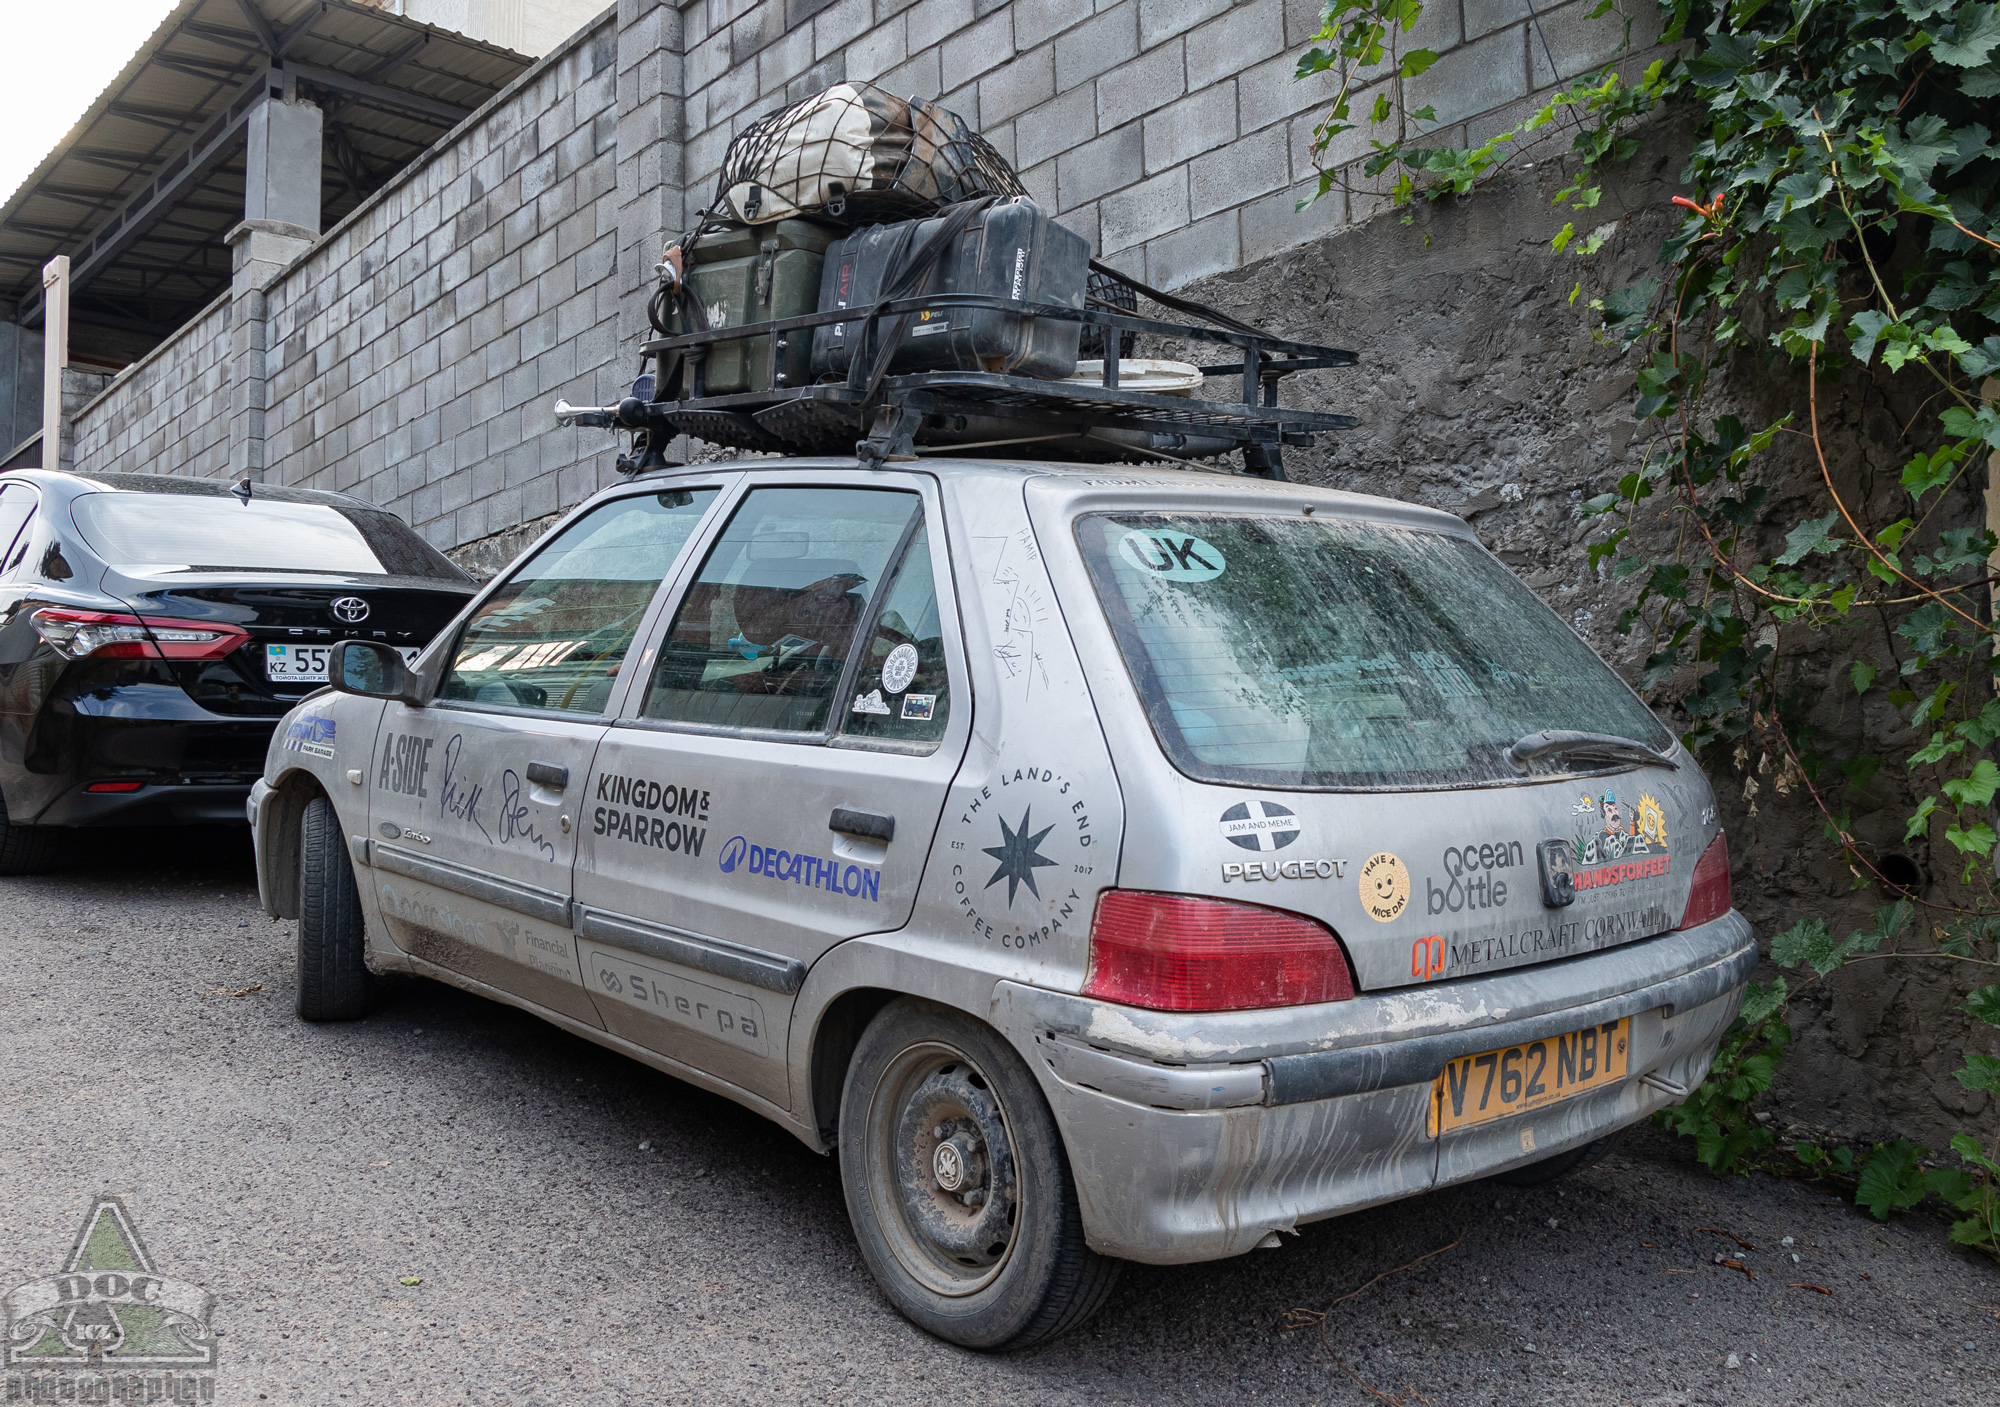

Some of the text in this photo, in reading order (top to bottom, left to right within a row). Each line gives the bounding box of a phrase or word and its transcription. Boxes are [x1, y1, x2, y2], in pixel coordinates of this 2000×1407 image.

[834, 263, 852, 337] PI AIR
[930, 310, 944, 318] PELI
[1124, 537, 1219, 572] UK
[288, 628, 413, 637] CAMRY
[269, 662, 287, 673] KZ
[295, 648, 331, 673] 55
[303, 745, 333, 757] PARK GARAGE
[596, 772, 711, 819] KINGDOM &
[961, 767, 1091, 847] THE LAND'S END
[593, 807, 707, 857] SPARROW
[1228, 819, 1293, 832] JAM AND MEME
[951, 840, 966, 851] EST.
[1443, 840, 1524, 876] ocean
[748, 844, 881, 902] DECATHLON
[1073, 864, 1093, 875] 2017
[1222, 858, 1348, 883] PEUGEOT
[1364, 854, 1396, 877] HAVE A
[1572, 855, 1671, 892] HANDSFORFEET
[952, 864, 1080, 949] COFFEE COMPANY
[1371, 894, 1406, 918] NICE DAY
[1426, 870, 1508, 915] bottle
[524, 930, 569, 959] Financial
[1450, 905, 1661, 968] METALCRAFT CORNWALL
[629, 974, 759, 1038] Sherpa
[1448, 1020, 1619, 1117] V762 NBT
